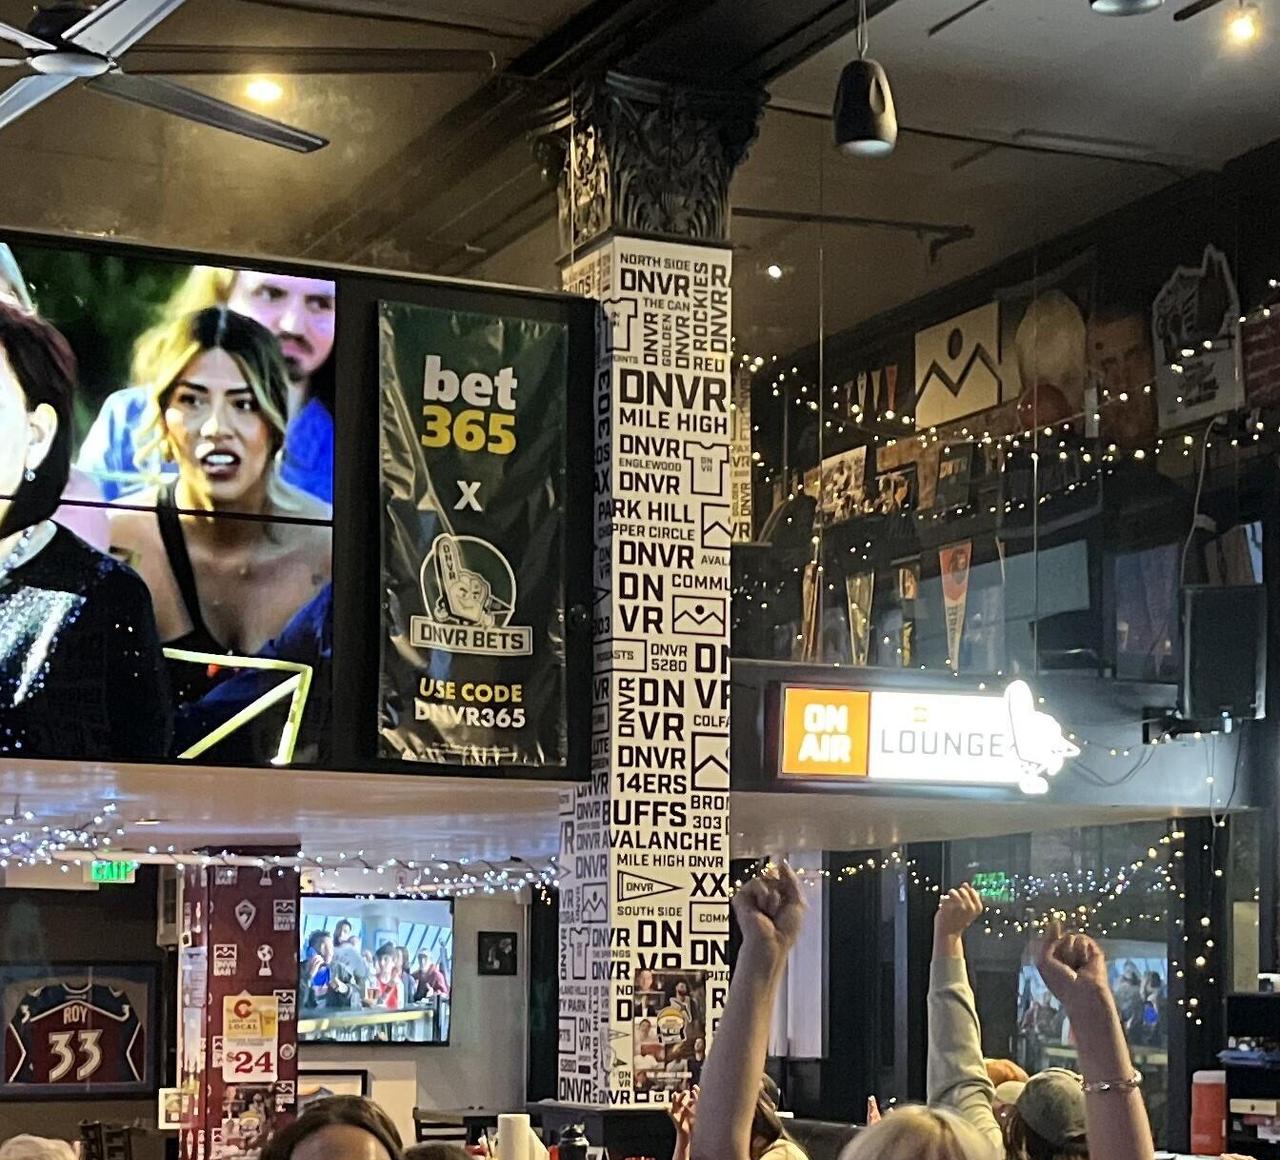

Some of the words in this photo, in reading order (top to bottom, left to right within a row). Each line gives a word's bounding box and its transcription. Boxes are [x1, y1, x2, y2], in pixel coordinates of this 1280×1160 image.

[620, 254, 660, 270] NORTH
[664, 259, 690, 272] SIDE
[621, 268, 690, 298] DNVR
[644, 297, 664, 309] THE
[668, 299, 690, 311] CAN
[693, 262, 708, 352] ROCKIES
[663, 314, 672, 367] GOLDEN
[676, 315, 689, 369] DNVR
[423, 355, 518, 410] bet
[421, 405, 517, 455] 365
[620, 408, 670, 431] MILE
[677, 412, 727, 435] HIGH
[620, 458, 682, 472] ENGLEWOOD
[621, 471, 680, 495] DNVR
[648, 500, 695, 524] HILL
[649, 526, 695, 541] CIRCLE
[620, 605, 663, 634] VR
[419, 623, 468, 647] DNVR
[473, 629, 523, 651] BETS
[652, 659, 687, 673] 5280
[420, 678, 455, 700] USE
[461, 681, 522, 704] CODE
[639, 678, 685, 709] DN
[415, 698, 525, 729] DNVR365
[804, 703, 848, 733] ON
[798, 734, 852, 763] AIR
[880, 729, 1005, 757] LOUNGE
[616, 774, 686, 796] 14ERS
[603, 800, 686, 827] BUFFS
[693, 815, 721, 829] 303
[602, 829, 721, 850] AVALANCHE
[576, 853, 608, 879] DNVR
[617, 853, 650, 867] MILE
[653, 854, 685, 867] HIGH
[688, 855, 724, 868] DNVR
[617, 906, 655, 917] SOUTH
[658, 906, 683, 917] SIDE
[63, 1005, 88, 1024] ROY
[48, 1029, 103, 1083] 33
[226, 1051, 275, 1074] $24
[560, 1077, 591, 1103] DNVR
